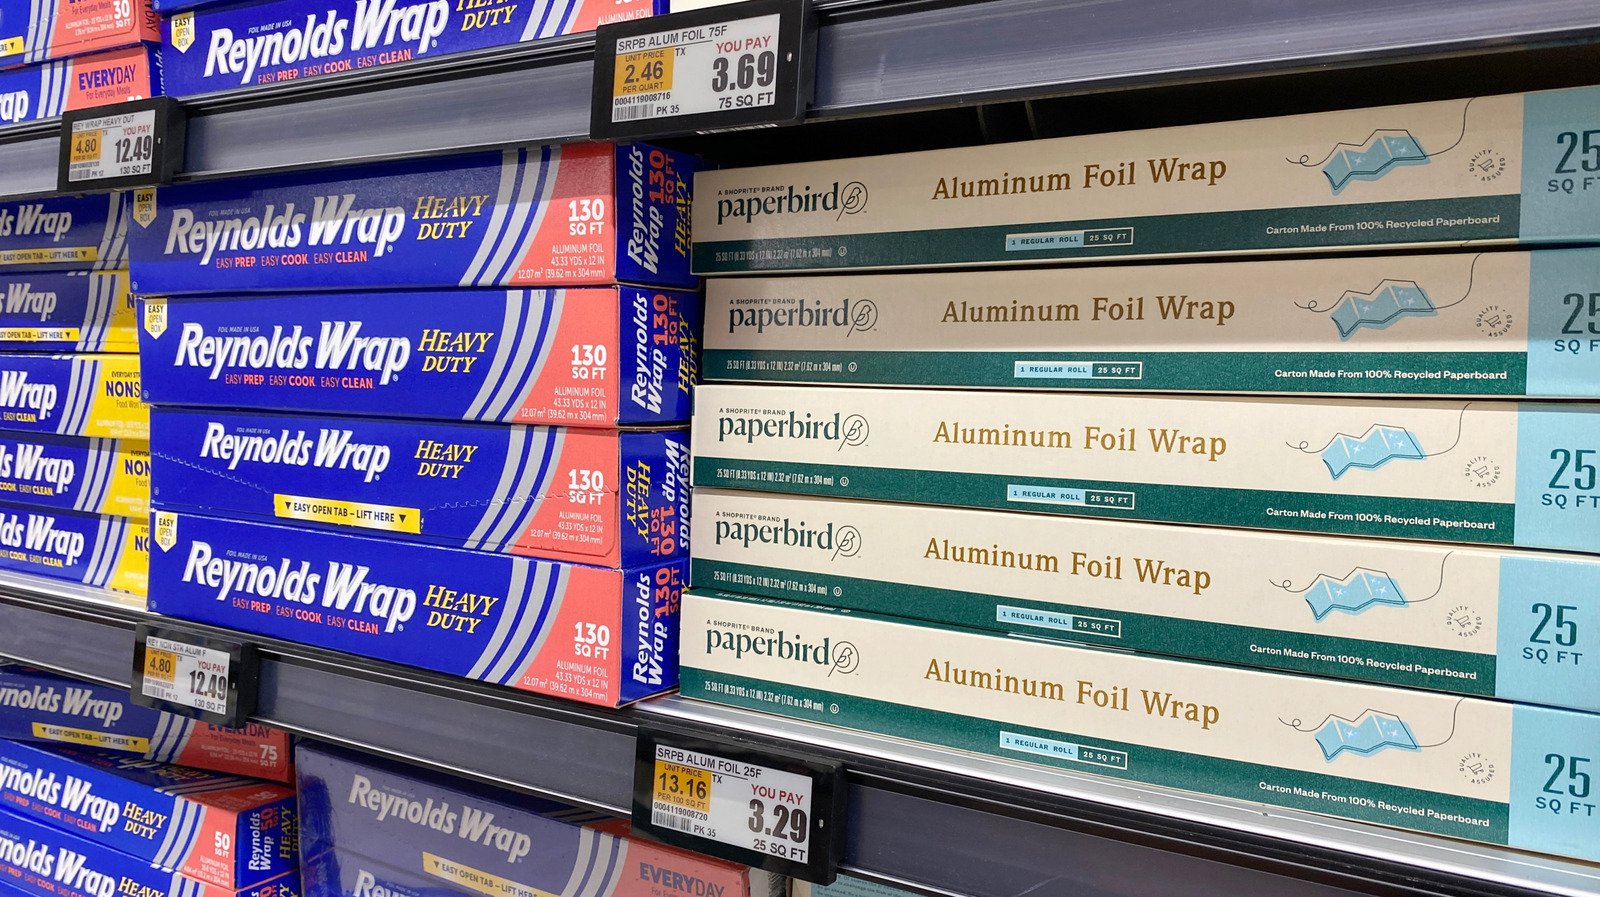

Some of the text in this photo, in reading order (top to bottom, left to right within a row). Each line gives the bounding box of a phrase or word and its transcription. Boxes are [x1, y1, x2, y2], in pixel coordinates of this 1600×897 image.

[461, 4, 517, 32] DUTY
[203, 0, 449, 84] Reynolds Wrap
[618, 26, 728, 52] SRPB ALUM FOIL 75F
[716, 35, 772, 54] YOU PAY
[625, 50, 665, 62] UNIT PRICE
[675, 47, 686, 57] TX
[79, 65, 136, 91] EVERYDAY
[625, 61, 664, 84] 2.46
[711, 51, 776, 93] 3.69
[622, 82, 664, 94] PER QUART
[656, 105, 680, 116] PK 35
[718, 92, 774, 109] 75 SQ FT
[73, 115, 135, 131] REY WRAP HEAVY DUT
[123, 124, 151, 136] YOU PAY
[76, 138, 97, 154] 4.80
[115, 135, 152, 163] 12.49
[120, 163, 151, 175] 130 SQ FT
[931, 158, 1227, 200] Aluminum Foil Wrap
[412, 195, 489, 220] HEAVY
[568, 198, 605, 222] 130
[717, 181, 839, 225] paperbird
[16, 203, 72, 242] Wrap
[164, 194, 405, 266] Reynolds Wrap
[417, 221, 473, 241] DUTY
[569, 222, 604, 236] SQ FT
[6, 283, 57, 322] Wrap
[148, 305, 164, 314] EASY
[941, 295, 1235, 326] Aluminum Foil Wrap
[149, 314, 163, 323] OPEN
[150, 323, 162, 332] BOX
[728, 298, 850, 334] paperbird
[174, 320, 411, 385] Reynolds Wrap
[417, 329, 494, 353] HEAVY
[421, 355, 477, 373] DUTY
[571, 345, 607, 366] 130
[225, 374, 242, 385] EASY
[269, 375, 287, 386] EASY
[320, 376, 340, 388] EASY
[572, 367, 607, 380] SQ FT
[1111, 367, 1122, 375] SQ
[1274, 369, 1507, 381] Carton Made From 100% Recycled Paperboard
[1, 370, 57, 420] Wrap
[718, 411, 840, 443] paperbird
[200, 422, 391, 483] Reynolds Wrap
[414, 439, 478, 463] HEAVY
[933, 420, 1227, 462] Aluminum Foil Wrap
[417, 462, 464, 479] DUTY
[568, 469, 604, 491] 130
[569, 491, 604, 505] SQ FT
[293, 502, 395, 523] EASY OPEN TAB LIFT HERE
[715, 518, 833, 550] paperbird
[923, 537, 1211, 595] Aluminum Foil Wrap
[181, 540, 417, 633] Reynolds Wrap
[422, 584, 499, 616] HEAVY
[426, 611, 482, 634] DUTY
[574, 621, 610, 645] 130
[751, 626, 775, 634] BRAND
[1529, 603, 1577, 646] 25
[574, 645, 609, 660] SQ FT
[706, 628, 830, 666] paperbird
[1522, 647, 1583, 665] SQ FT
[149, 657, 171, 673] 4.80
[197, 660, 226, 674] YOU PAY
[189, 670, 228, 700] 12.49
[924, 658, 1220, 730] Aluminum Foil Wrap
[194, 698, 226, 713] 130 SQ FT
[657, 748, 762, 778] SRPB ALUM FOIL 25F
[664, 763, 703, 778] UNIT PRICE
[659, 773, 707, 799] 13.16
[711, 774, 723, 784] TX
[1542, 753, 1591, 798] 25
[657, 792, 706, 809] PER 100 SQ FT
[751, 784, 804, 805] YOU PAY
[1535, 797, 1596, 816] SQ FT
[348, 774, 531, 865] Reynolds Wrap
[694, 824, 716, 838] PK 35
[748, 798, 808, 843] 3.29
[214, 831, 230, 848] 50
[753, 838, 806, 861] 25 SQ FT
[639, 862, 725, 897] EVERYDAY
